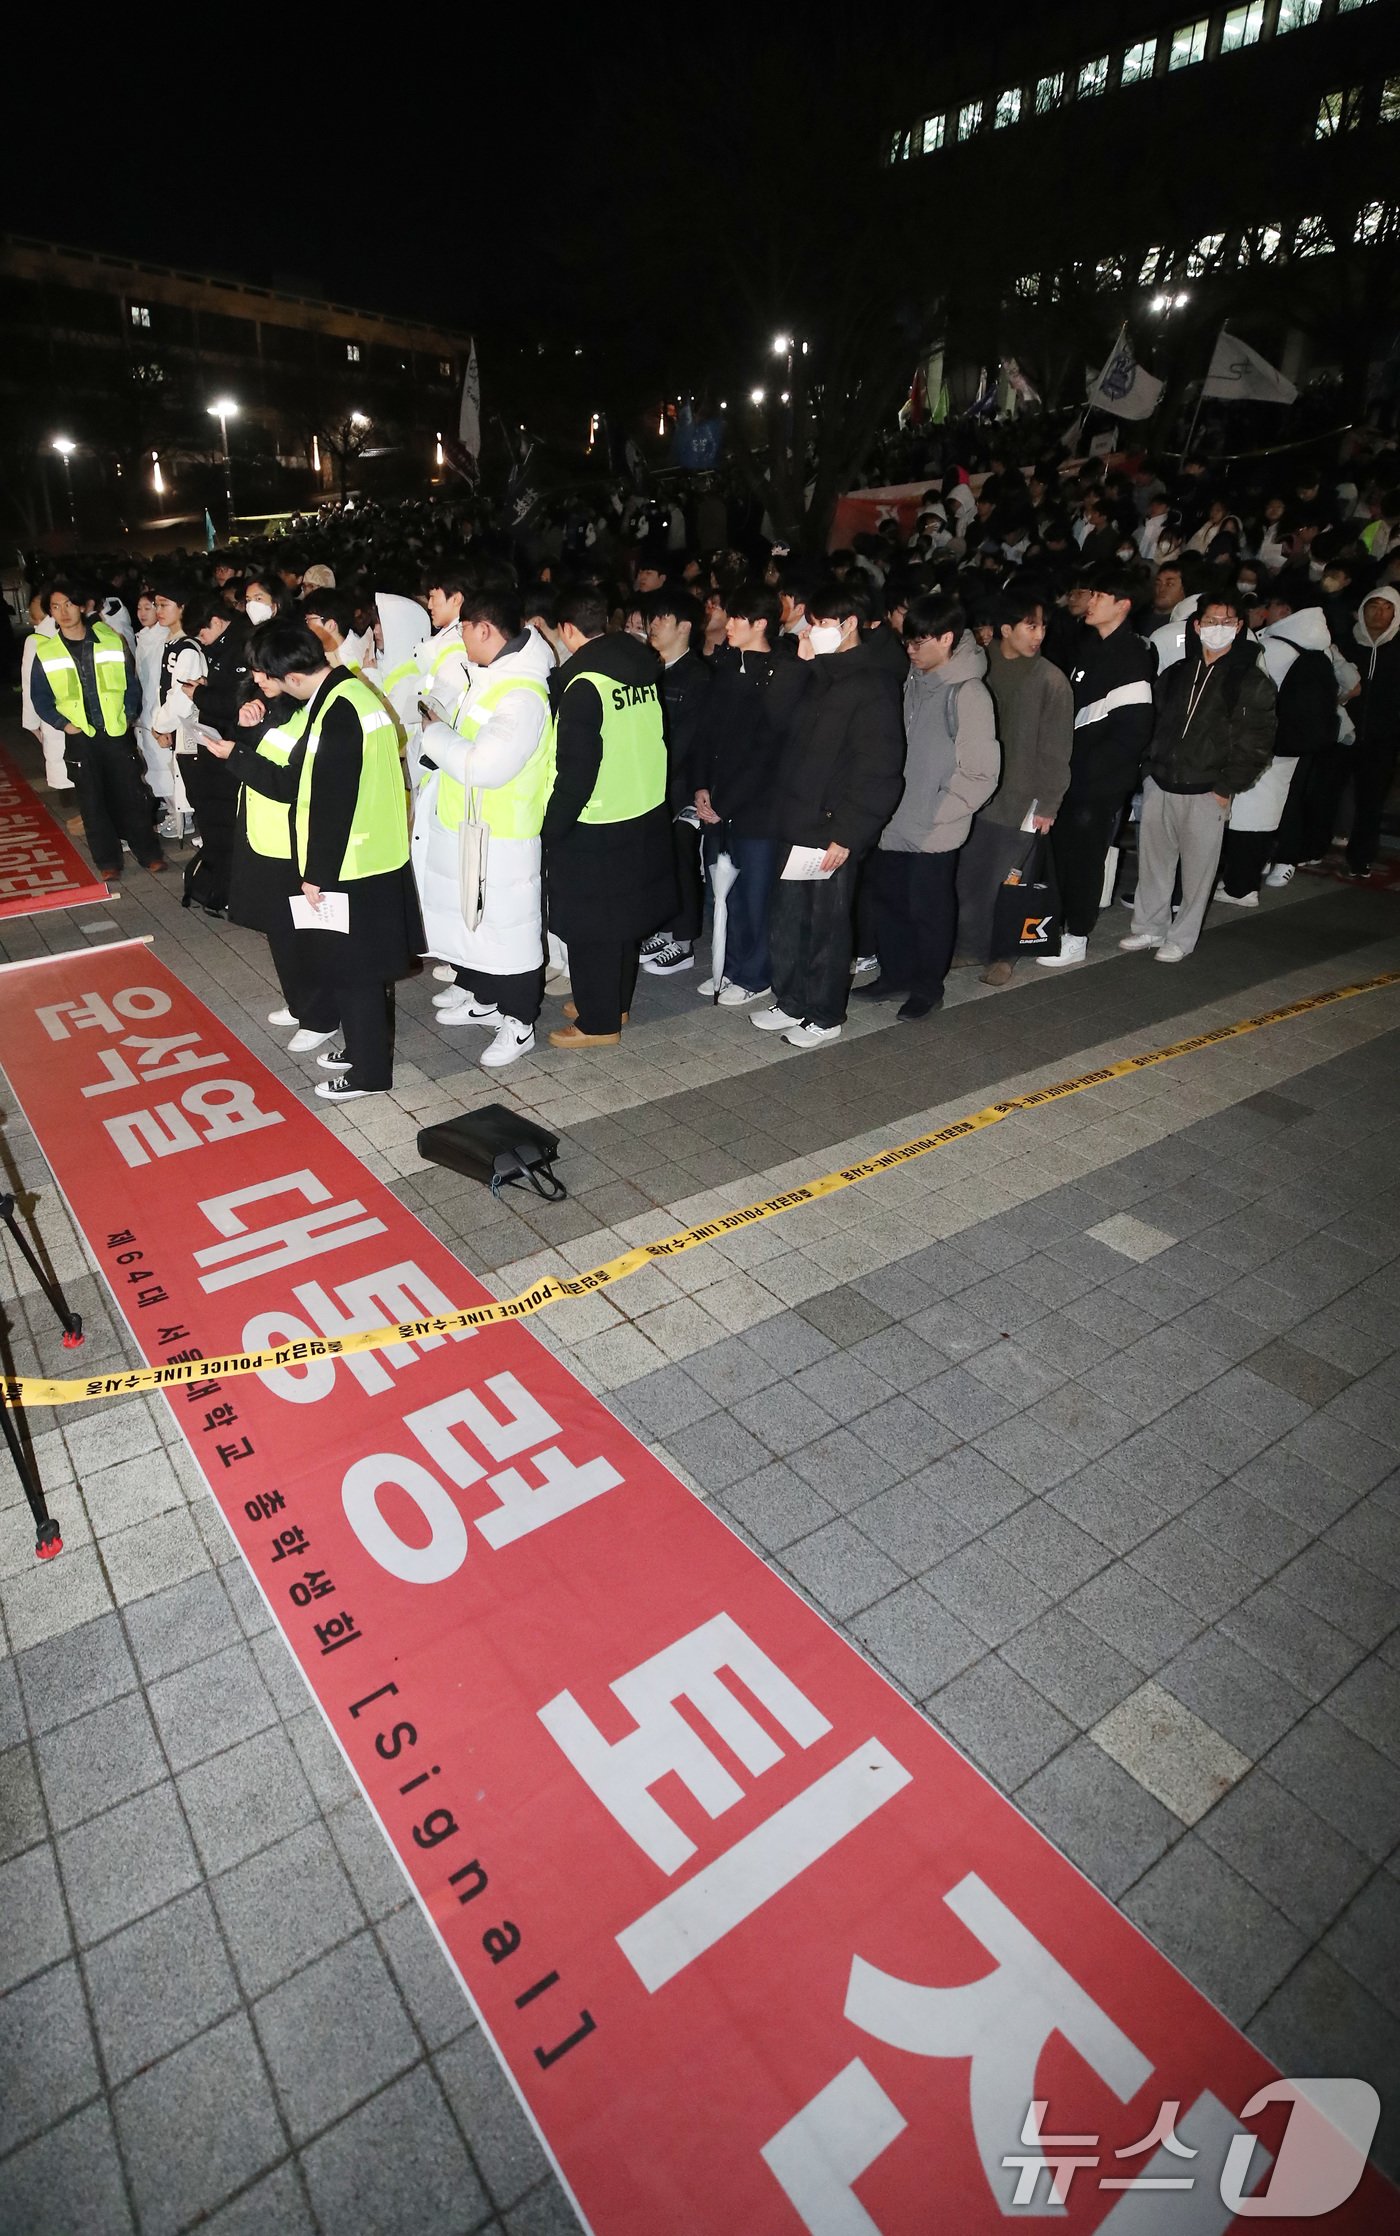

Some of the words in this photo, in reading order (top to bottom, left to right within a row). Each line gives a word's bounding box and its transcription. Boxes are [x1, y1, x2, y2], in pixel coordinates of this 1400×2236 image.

[718, 1188, 815, 1229] 출입금지-POLICE
[645, 1224, 721, 1256] LINE-수사중
[34, 985, 287, 1168] 윤석열
[193, 1168, 625, 1585] 대통령
[398, 1308, 495, 1339] LINE-수사중
[200, 1340, 344, 1377] 출입금지-POLICE
[86, 1366, 192, 1397] LINE-수사중
[106, 1228, 170, 1309] 제64대
[244, 1488, 363, 1656] 총학생회
[347, 1681, 598, 2071] [Signal]
